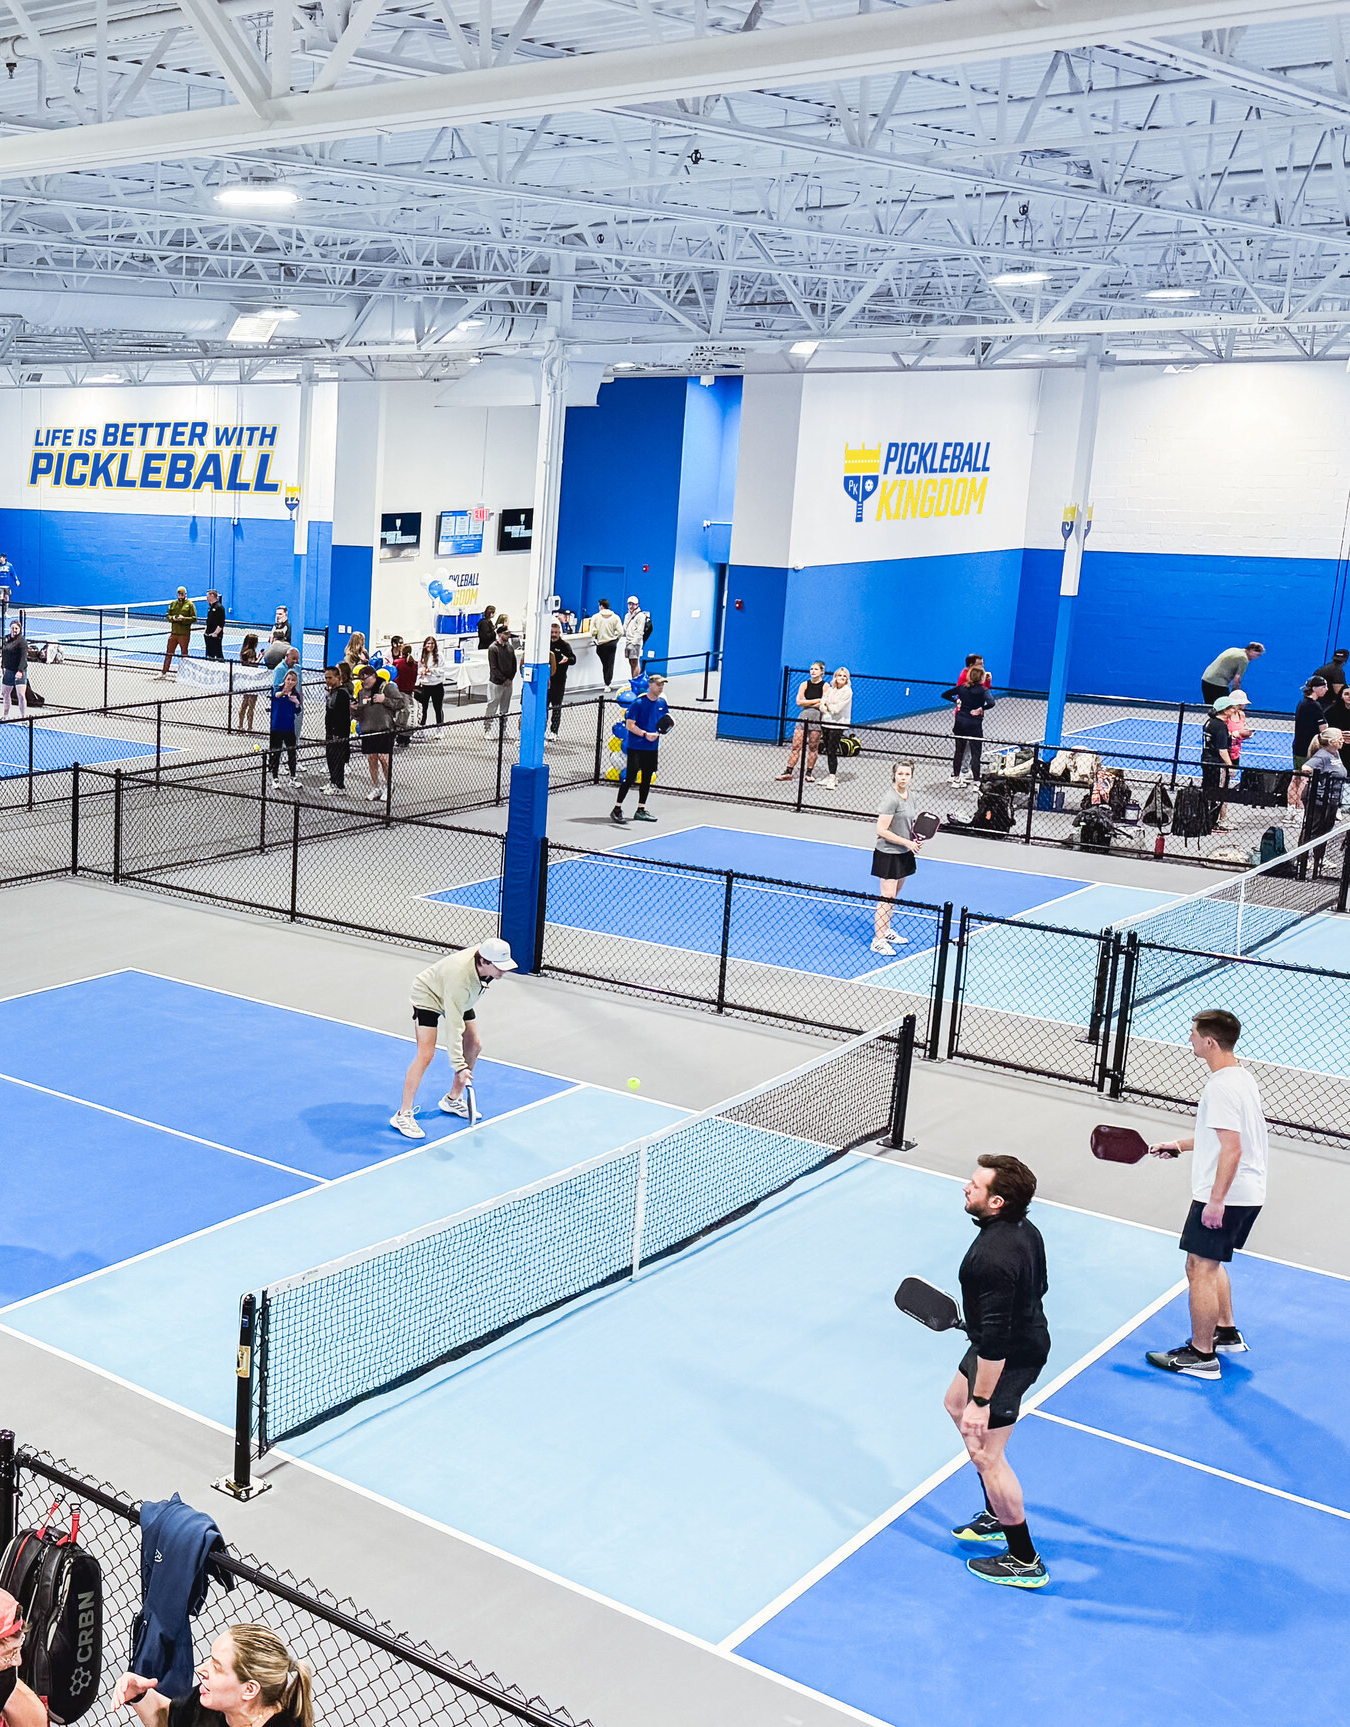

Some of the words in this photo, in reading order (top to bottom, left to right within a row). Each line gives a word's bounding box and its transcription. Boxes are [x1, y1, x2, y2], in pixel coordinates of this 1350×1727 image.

[34, 428, 74, 447] LIFE
[77, 428, 97, 447] IS
[102, 421, 209, 447] BETTER
[214, 426, 278, 447] WITH
[29, 452, 280, 492] PICKLEBALL
[883, 442, 991, 475] PICKLEBALL
[875, 477, 989, 522] KINGDOM
[76, 1590, 95, 1663] CRBN
